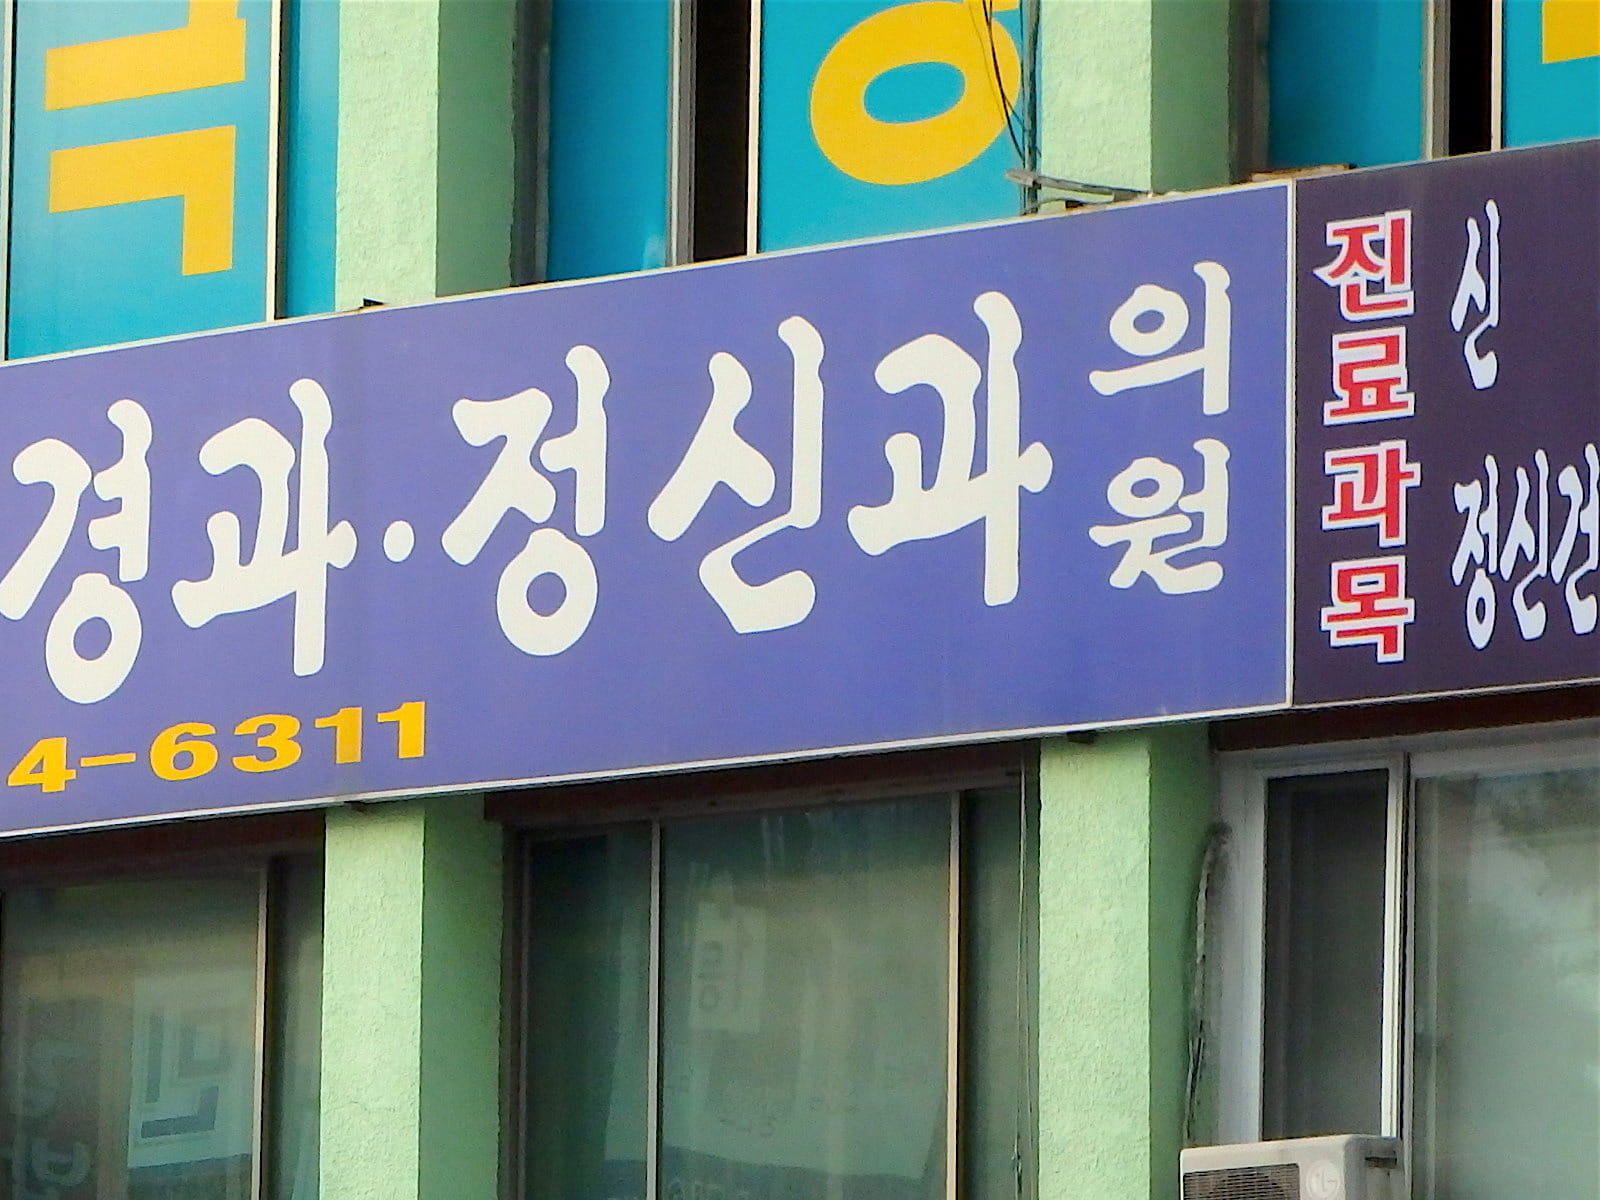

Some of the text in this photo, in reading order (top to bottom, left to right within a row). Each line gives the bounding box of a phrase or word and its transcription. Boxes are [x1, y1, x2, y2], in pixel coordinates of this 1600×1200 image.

[1088, 261, 1231, 594] 의원
[1313, 209, 1421, 664] 진료과목
[1451, 199, 1500, 390] 신
